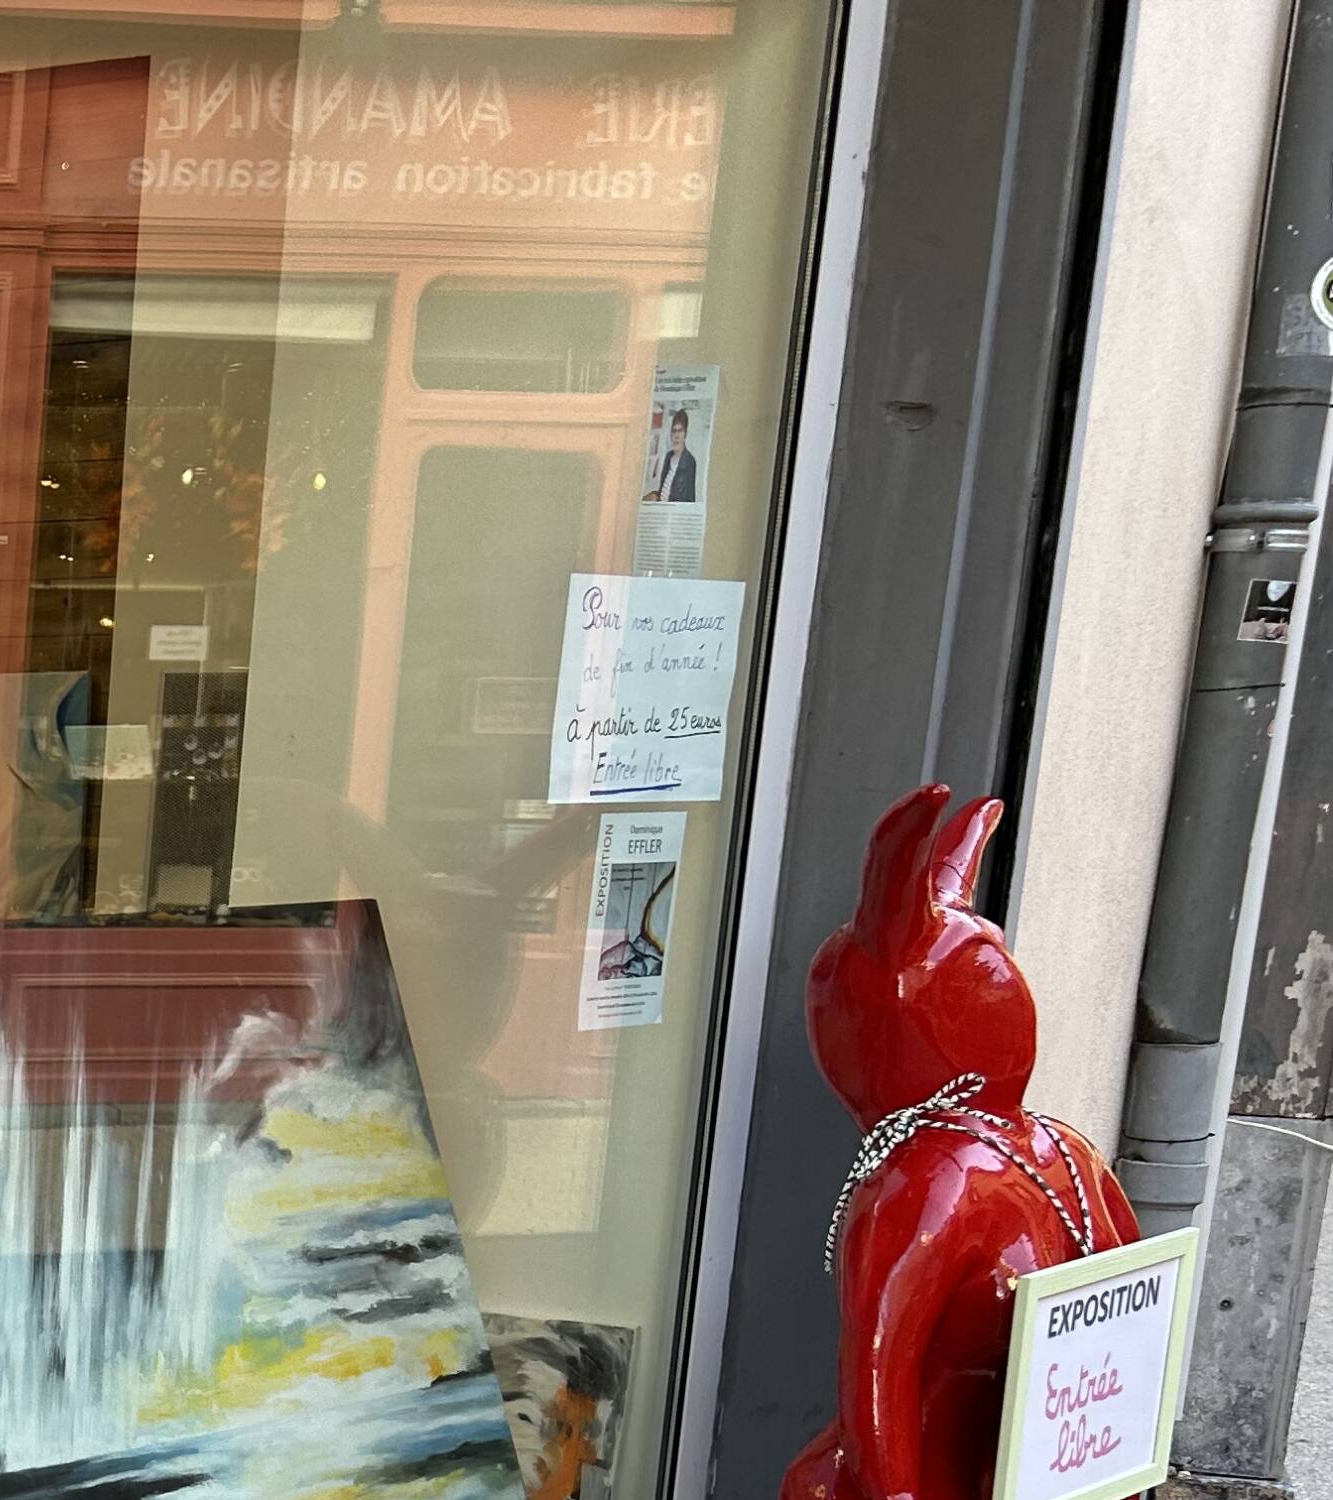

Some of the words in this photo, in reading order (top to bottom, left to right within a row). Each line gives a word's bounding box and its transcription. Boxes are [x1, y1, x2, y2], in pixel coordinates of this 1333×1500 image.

[582, 586, 623, 631] Pour
[660, 603, 726, 635] cadeaux
[583, 653, 602, 683] de
[611, 647, 634, 699] fin
[585, 708, 639, 761] partir
[643, 707, 662, 733] de
[593, 750, 638, 785] Entrée
[643, 751, 683, 786] libre
[628, 838, 663, 854] EFFLER
[630, 824, 664, 835] Dominique
[595, 823, 615, 918] EXPOSITION
[1047, 1275, 1161, 1339] EXPOSITION
[1045, 1352, 1124, 1420] Entrée
[1049, 1413, 1122, 1473] libre
